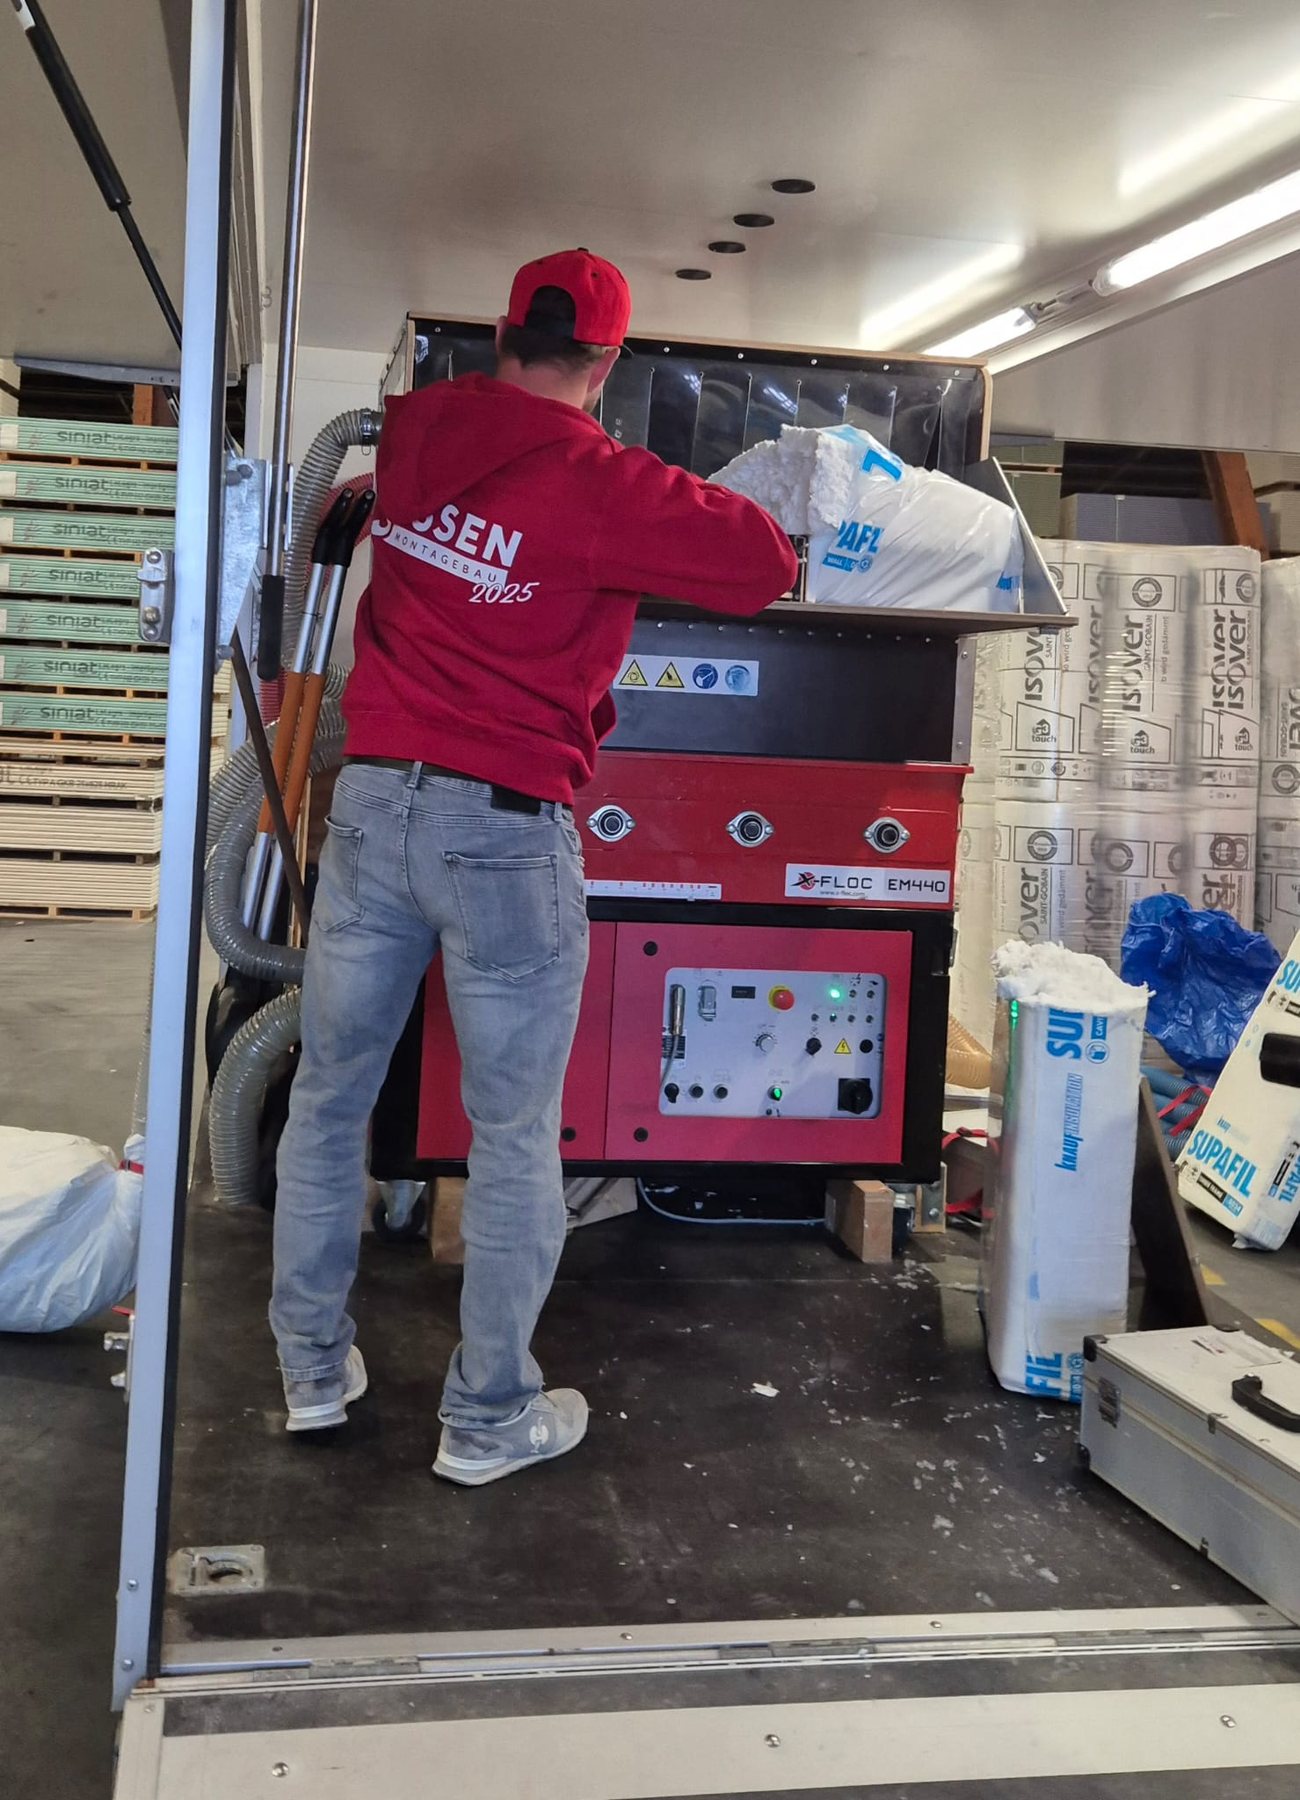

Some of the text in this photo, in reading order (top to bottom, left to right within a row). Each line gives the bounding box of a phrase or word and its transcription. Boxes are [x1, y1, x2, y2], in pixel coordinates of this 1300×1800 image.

[371, 504, 523, 568] SEN
[394, 533, 497, 583] MONTAGEBAU
[468, 582, 541, 604] 2025
[1032, 735, 1057, 743] touch
[1130, 746, 1155, 754] touch
[888, 878, 946, 893] EM440
[1187, 1129, 1257, 1199] SUPAFIL
